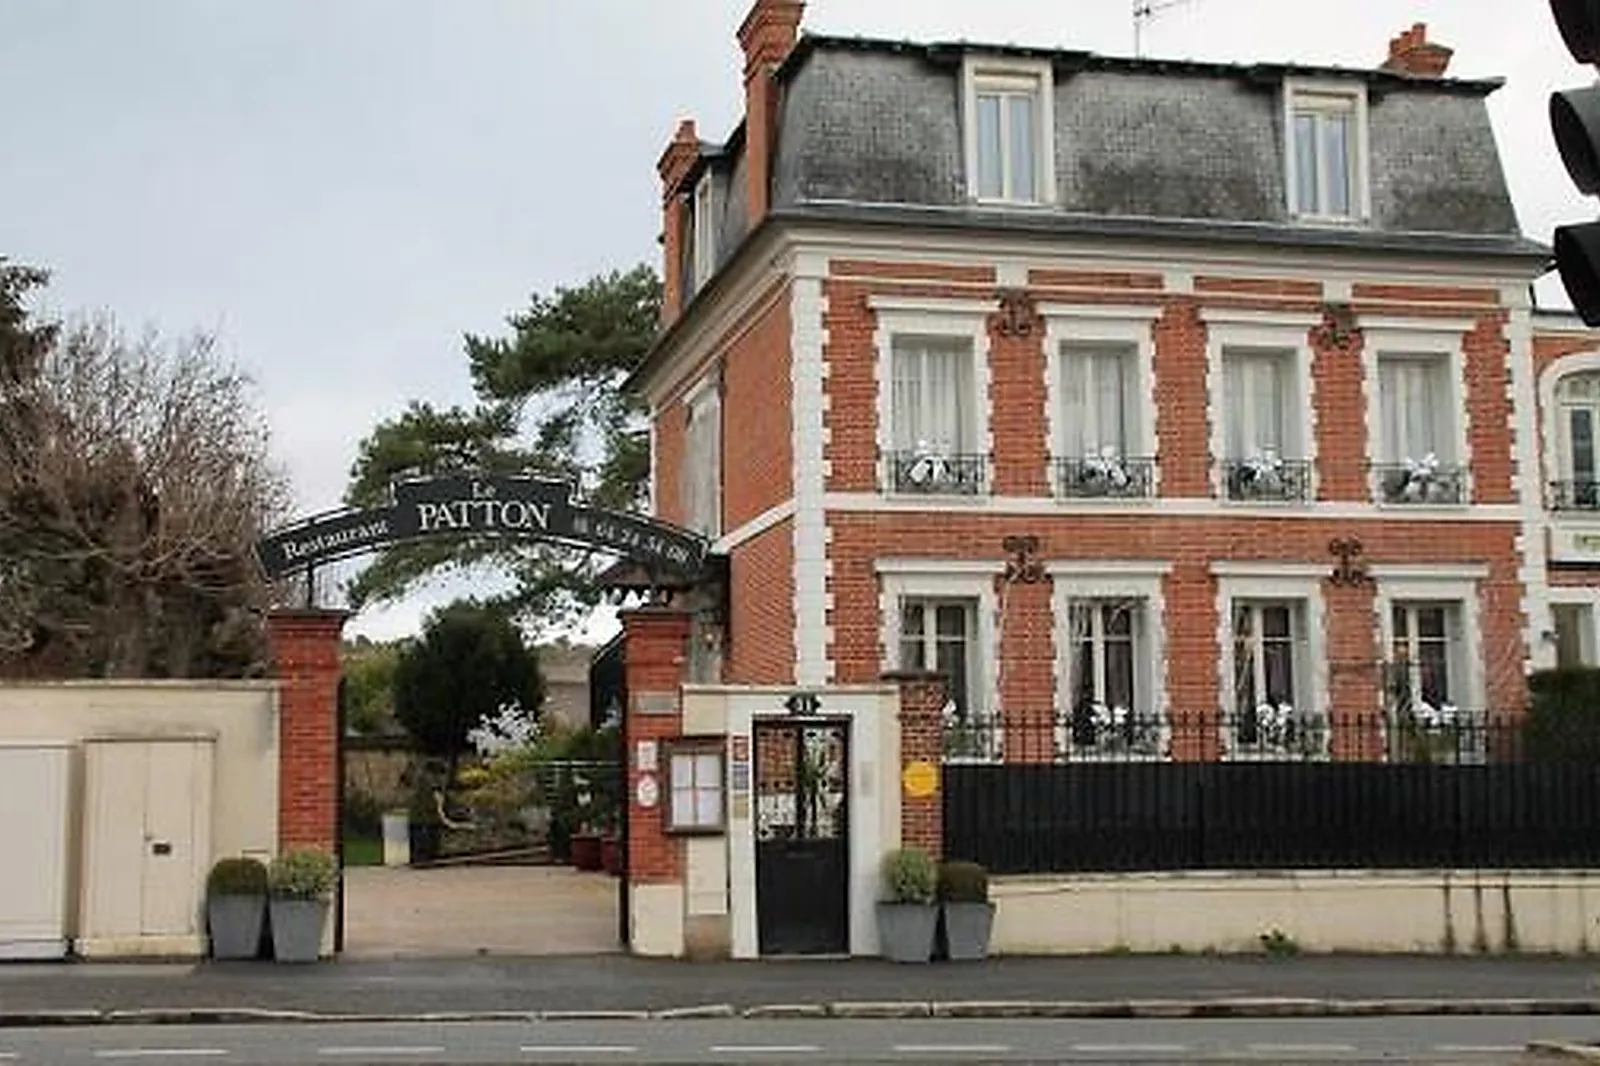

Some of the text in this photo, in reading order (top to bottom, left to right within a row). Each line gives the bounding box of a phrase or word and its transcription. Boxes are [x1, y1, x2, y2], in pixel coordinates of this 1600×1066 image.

[472, 482, 497, 498] Le
[416, 499, 552, 530] PATTON
[282, 519, 389, 560] Restaurant
